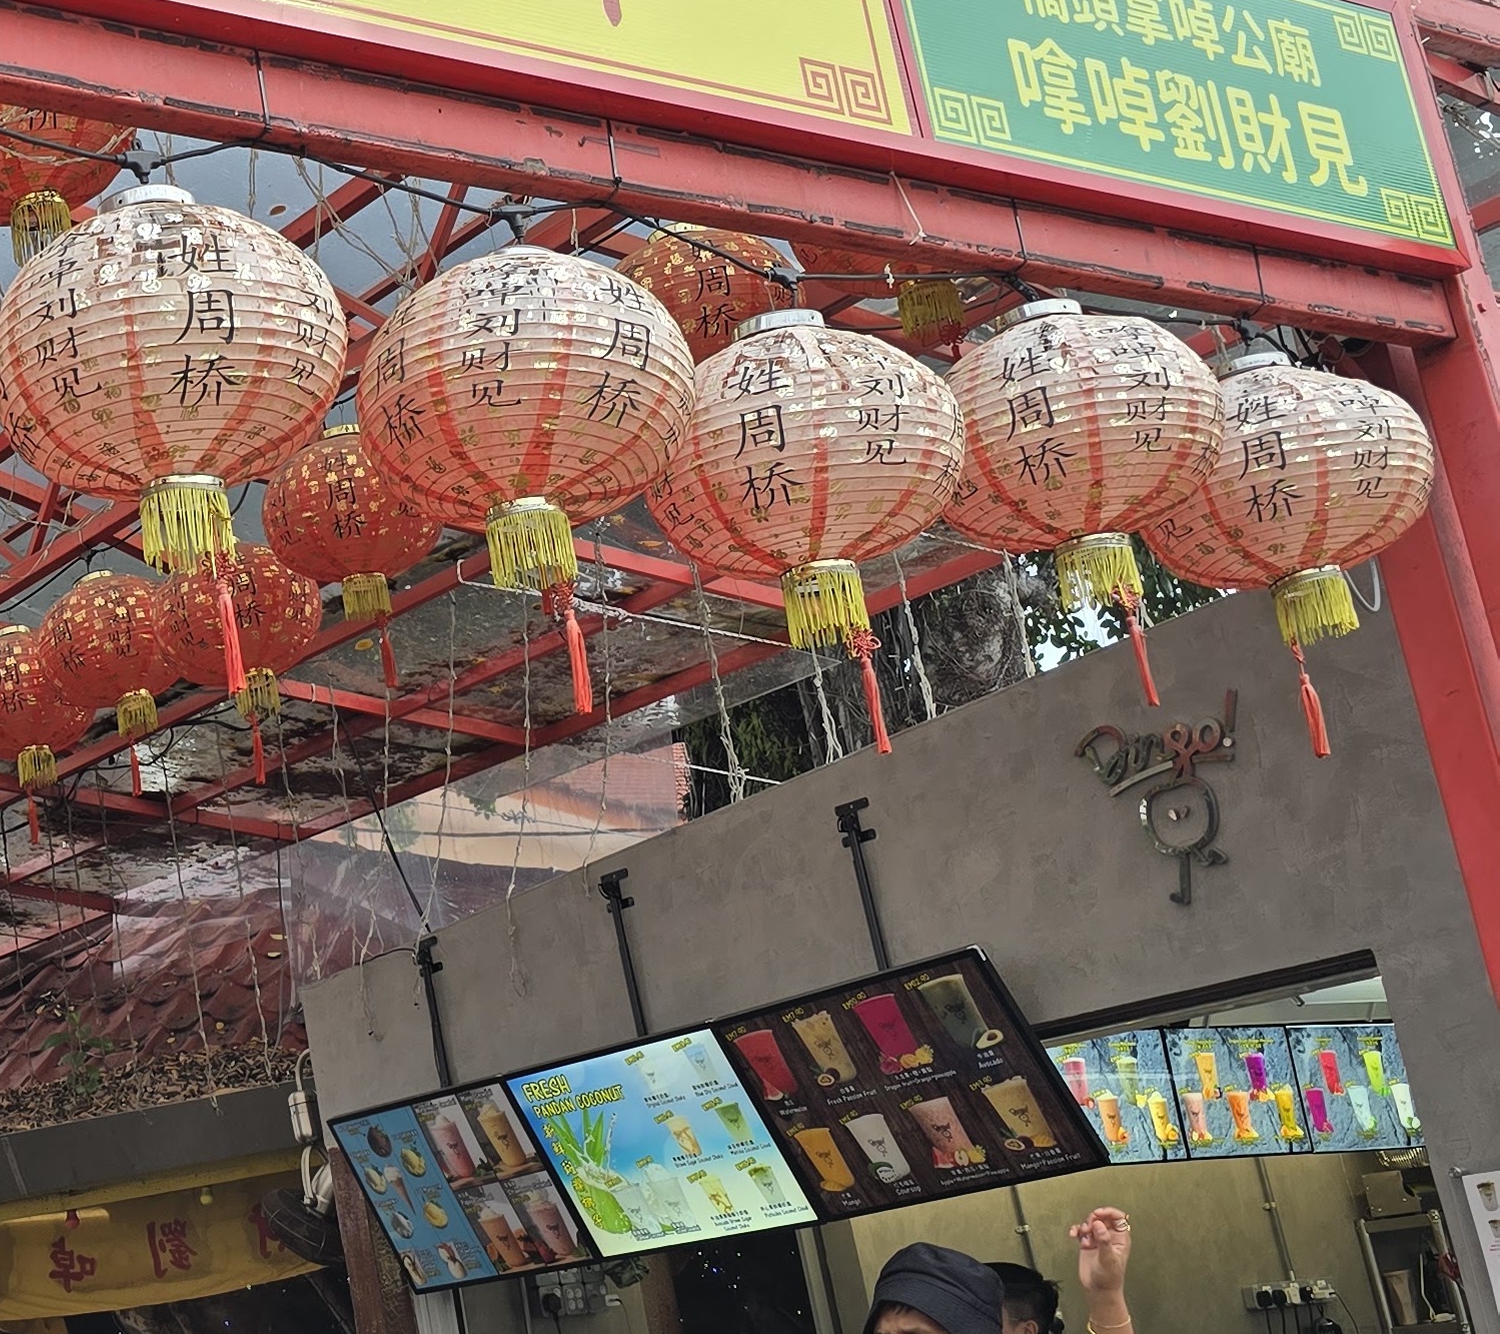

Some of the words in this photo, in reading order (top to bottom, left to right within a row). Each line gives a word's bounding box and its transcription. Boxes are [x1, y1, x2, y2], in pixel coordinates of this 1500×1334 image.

[165, 233, 244, 408] 姓周桥
[727, 358, 805, 511] 姓周桥
[993, 347, 1077, 486] 姓周桥
[1226, 395, 1306, 523] 姓周桥
[521, 1074, 571, 1102] FRESH
[532, 1098, 575, 1119] PANDAN
[575, 1084, 624, 1110] COCONUT
